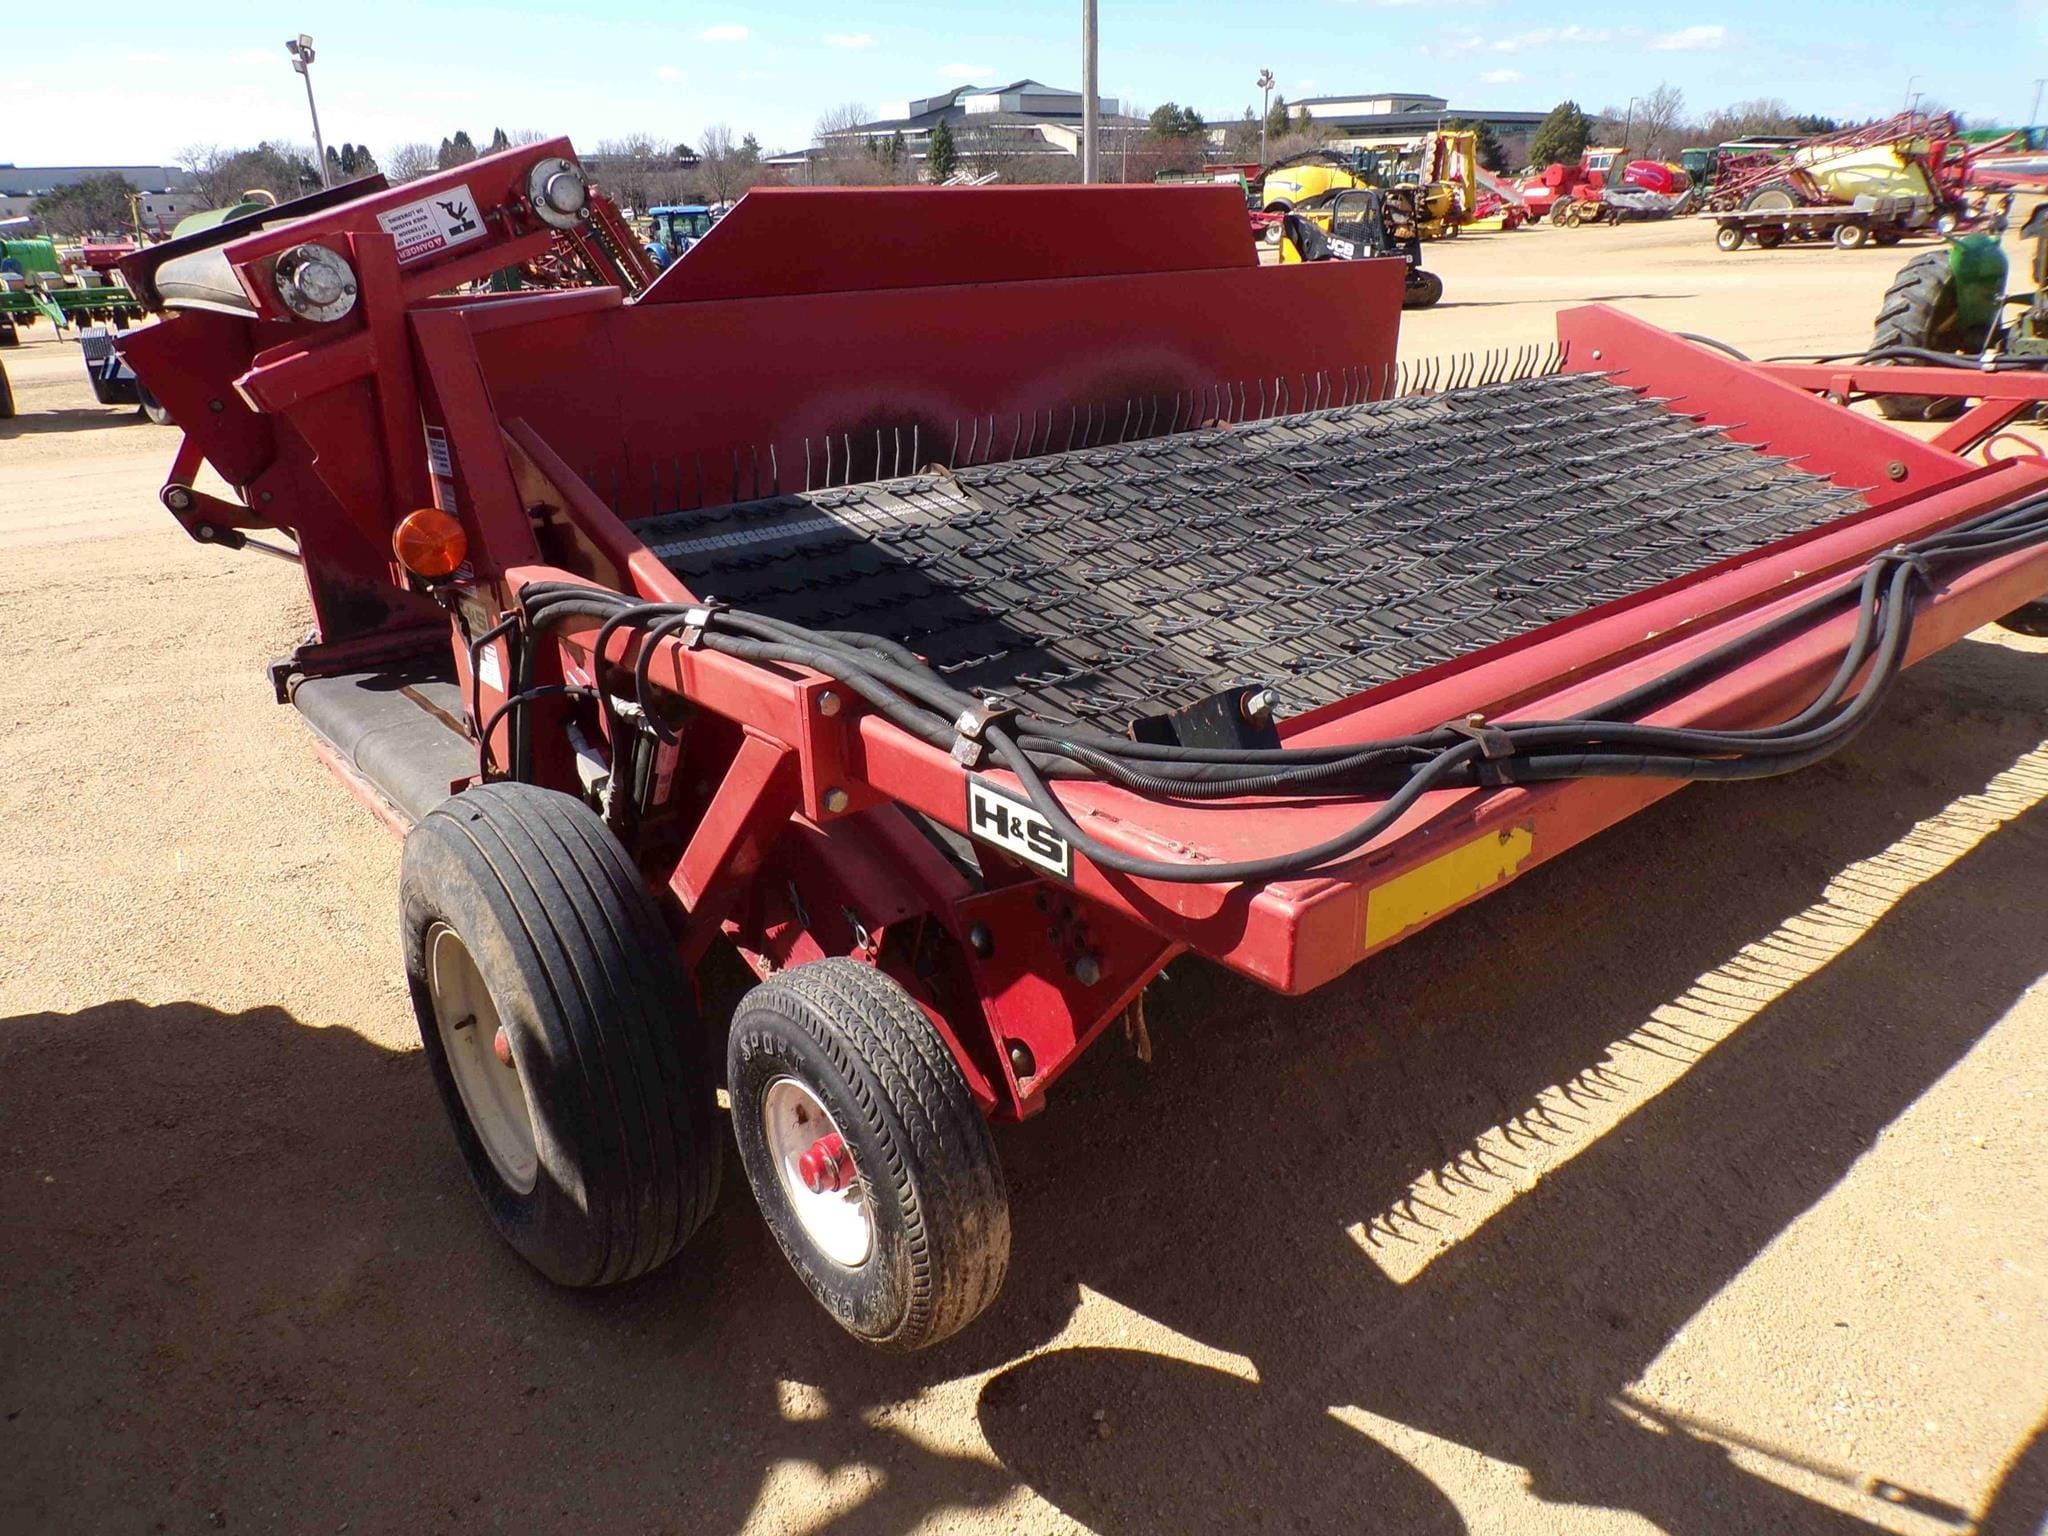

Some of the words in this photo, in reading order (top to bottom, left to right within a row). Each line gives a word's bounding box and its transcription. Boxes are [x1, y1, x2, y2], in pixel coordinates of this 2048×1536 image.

[388, 210, 416, 224] LOWERING
[413, 215, 428, 224] WHEN
[390, 220, 412, 231] RAISING
[398, 223, 428, 237] EXTENSION
[404, 234, 422, 244] CLEAR
[423, 229, 436, 238] STAY
[398, 240, 435, 259] DANGER
[1326, 237, 1354, 257] JCB
[975, 794, 1063, 863] H&S
[740, 1030, 806, 1072] SPORT
